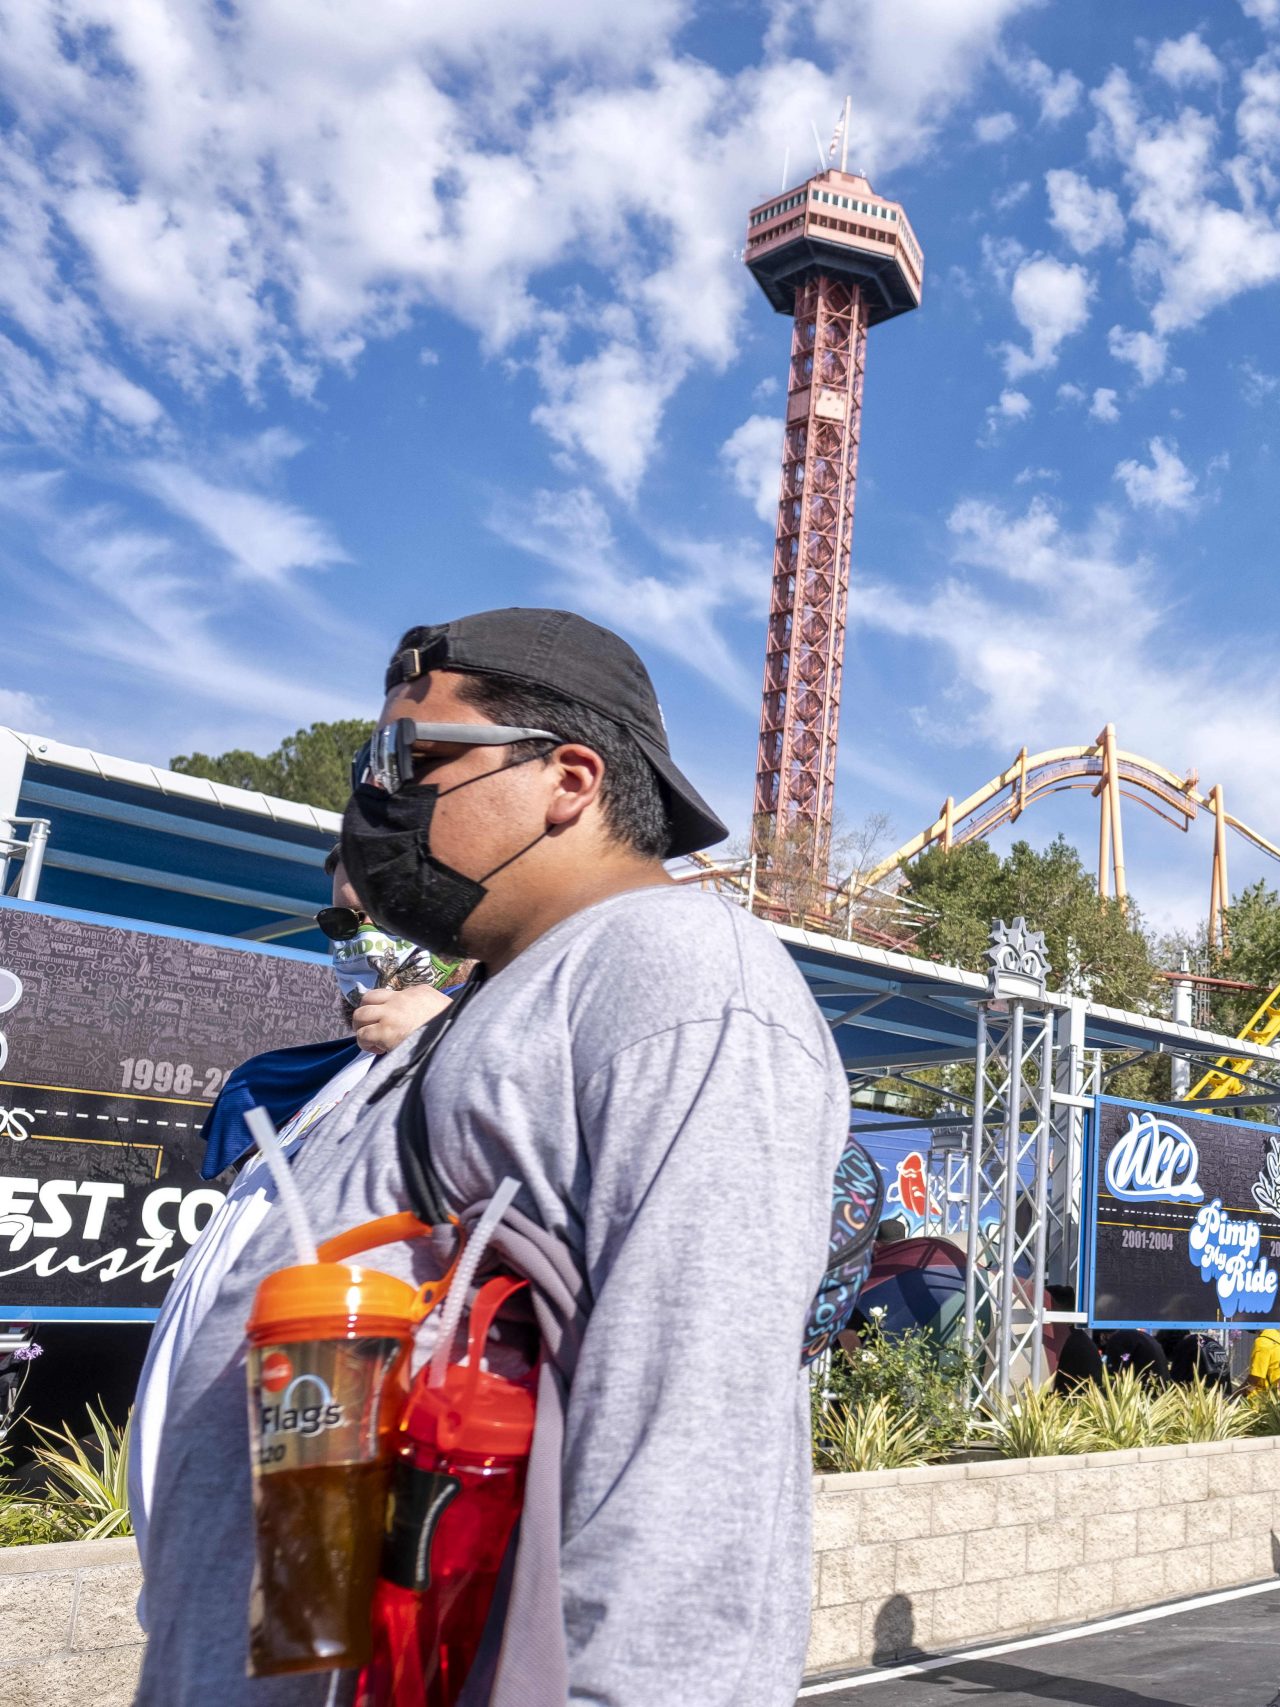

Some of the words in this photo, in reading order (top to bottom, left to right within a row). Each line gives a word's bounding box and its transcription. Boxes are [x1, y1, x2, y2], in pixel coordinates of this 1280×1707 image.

[8, 912, 23, 956] AUTOMO
[50, 933, 82, 945] RENDER
[92, 941, 121, 951] REALITY
[76, 926, 120, 943] AMBITION
[51, 941, 73, 951] WEST
[75, 945, 99, 956] COAST
[2, 956, 32, 969] WEST
[36, 962, 77, 976] COAST
[80, 969, 135, 986] CUSTOMS
[147, 980, 174, 992] WEST
[177, 985, 214, 998] COAST
[217, 991, 267, 1007] CUSTOMS
[155, 1015, 177, 1025] 1993
[119, 1057, 231, 1098] 1998-2
[0, 1176, 125, 1241] EST
[141, 1187, 227, 1246] CO
[1122, 1229, 1174, 1252] 2001-2004
[1190, 1200, 1260, 1257] Pimp
[1201, 1243, 1227, 1270] My
[1217, 1254, 1278, 1299] Ride
[260, 1403, 344, 1436] Flags
